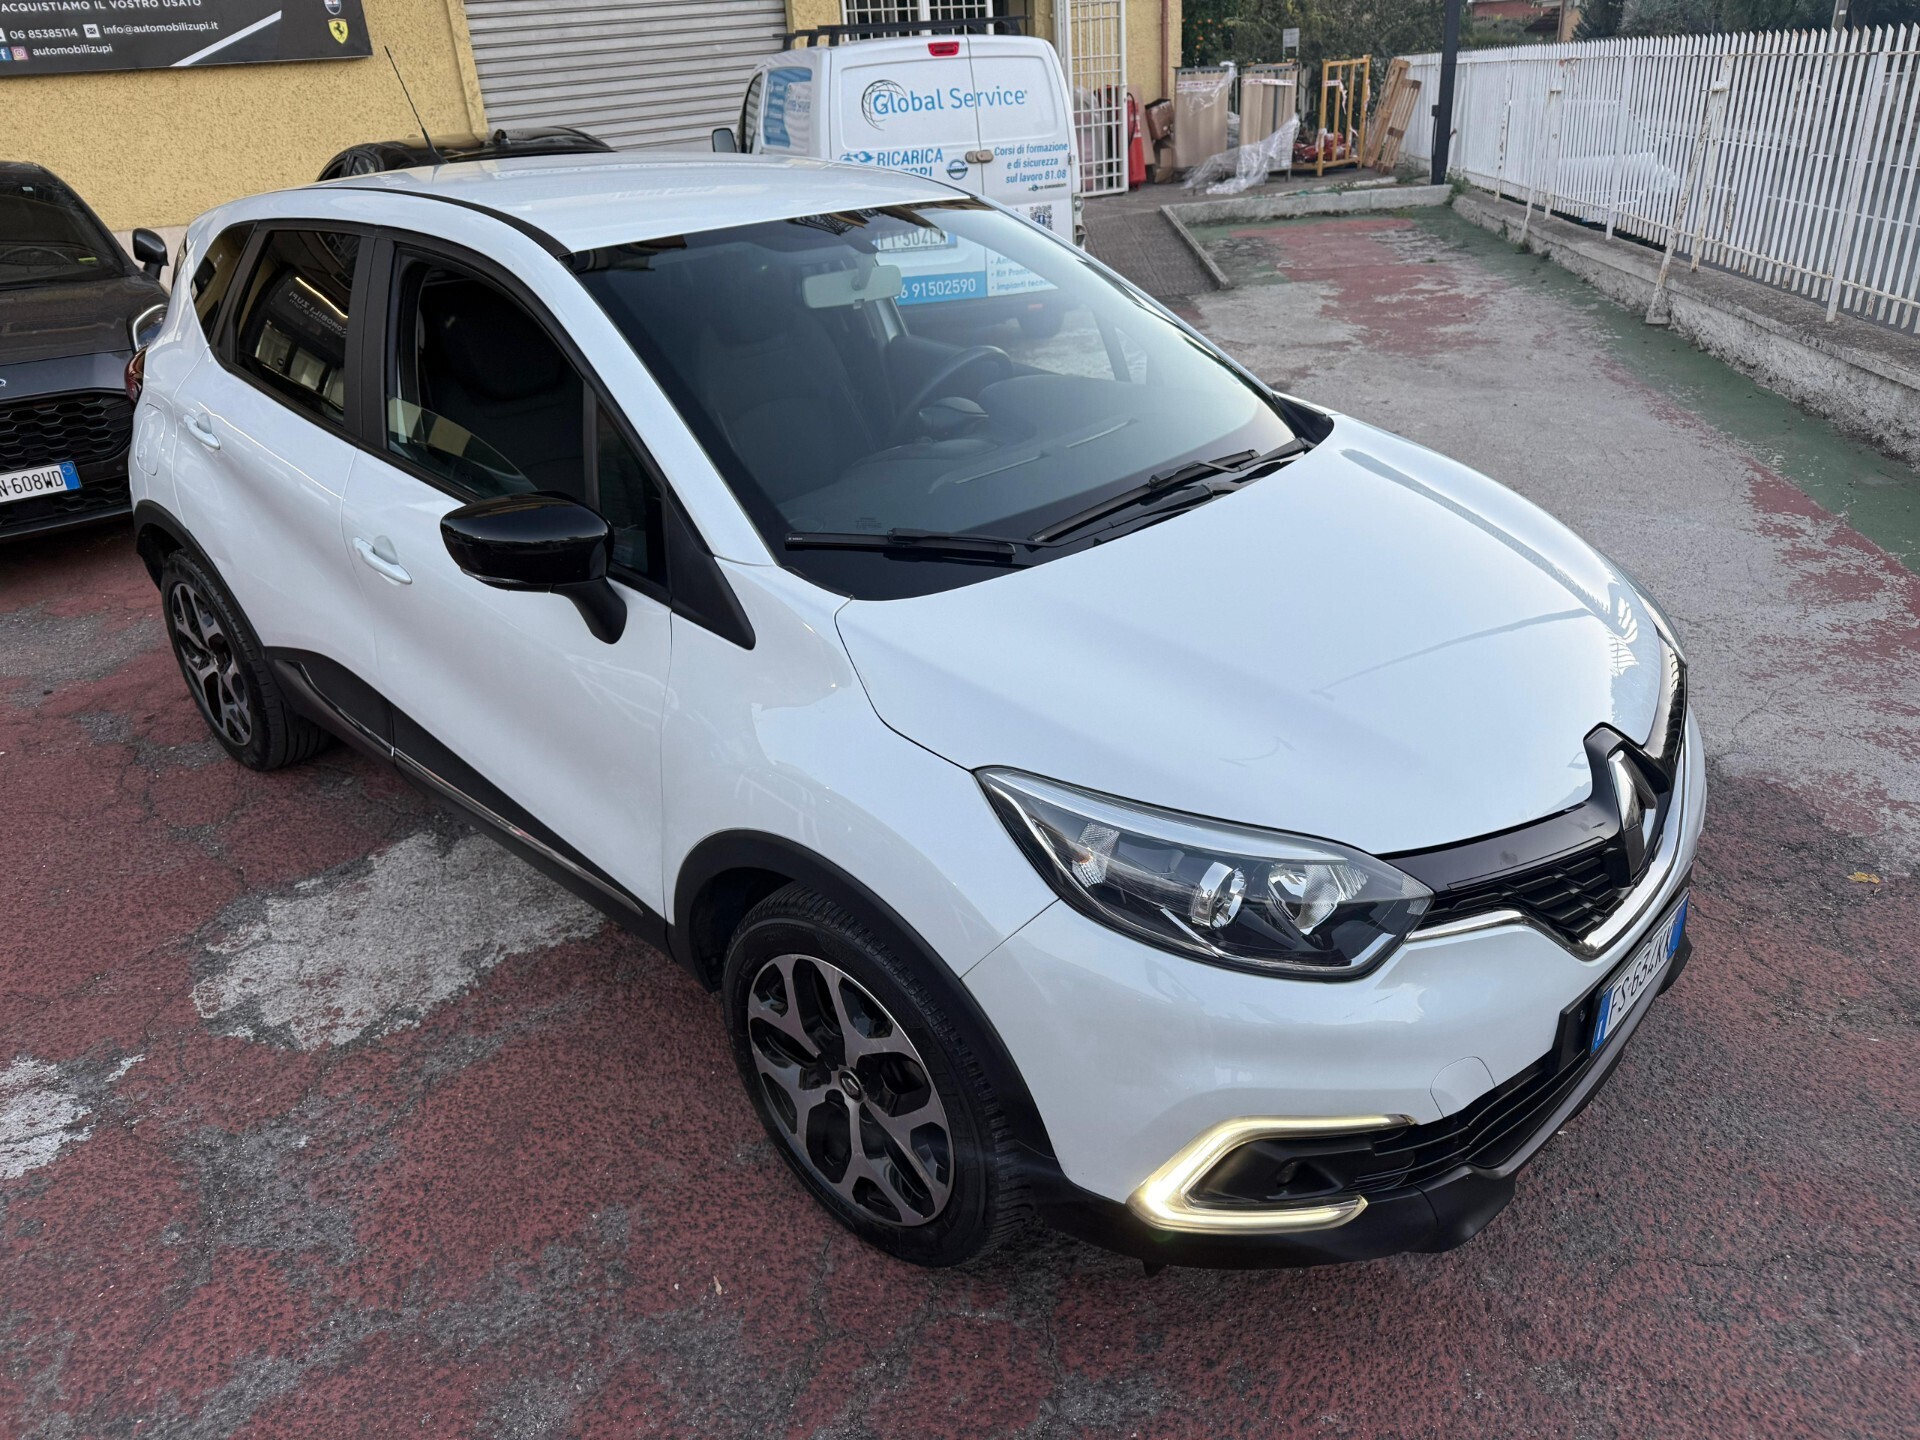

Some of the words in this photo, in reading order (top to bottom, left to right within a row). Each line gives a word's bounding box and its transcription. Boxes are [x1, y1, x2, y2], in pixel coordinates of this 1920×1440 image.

[1, 1, 90, 13] ACQUISTIAMO
[94, 0, 106, 10] IL
[109, 0, 159, 9] VOSTRO
[9, 30, 26, 40] 06
[27, 28, 78, 39] 85385114
[102, 21, 219, 35] info@automobilizupi.it
[32, 43, 113, 56] automobilizupi
[873, 88, 944, 116] Global
[949, 85, 1026, 110] Service
[994, 146, 1016, 156] Corsi
[1016, 144, 1025, 154] di
[1026, 142, 1068, 154] formazione
[876, 147, 944, 167] RICARICA
[1006, 161, 1013, 170] e
[1013, 158, 1022, 169] di
[1022, 157, 1059, 168] sicurezza
[1005, 173, 1019, 184] sul
[1019, 172, 1043, 183] lavoro
[1044, 169, 1067, 180] 81.08
[911, 278, 977, 298] 91502590
